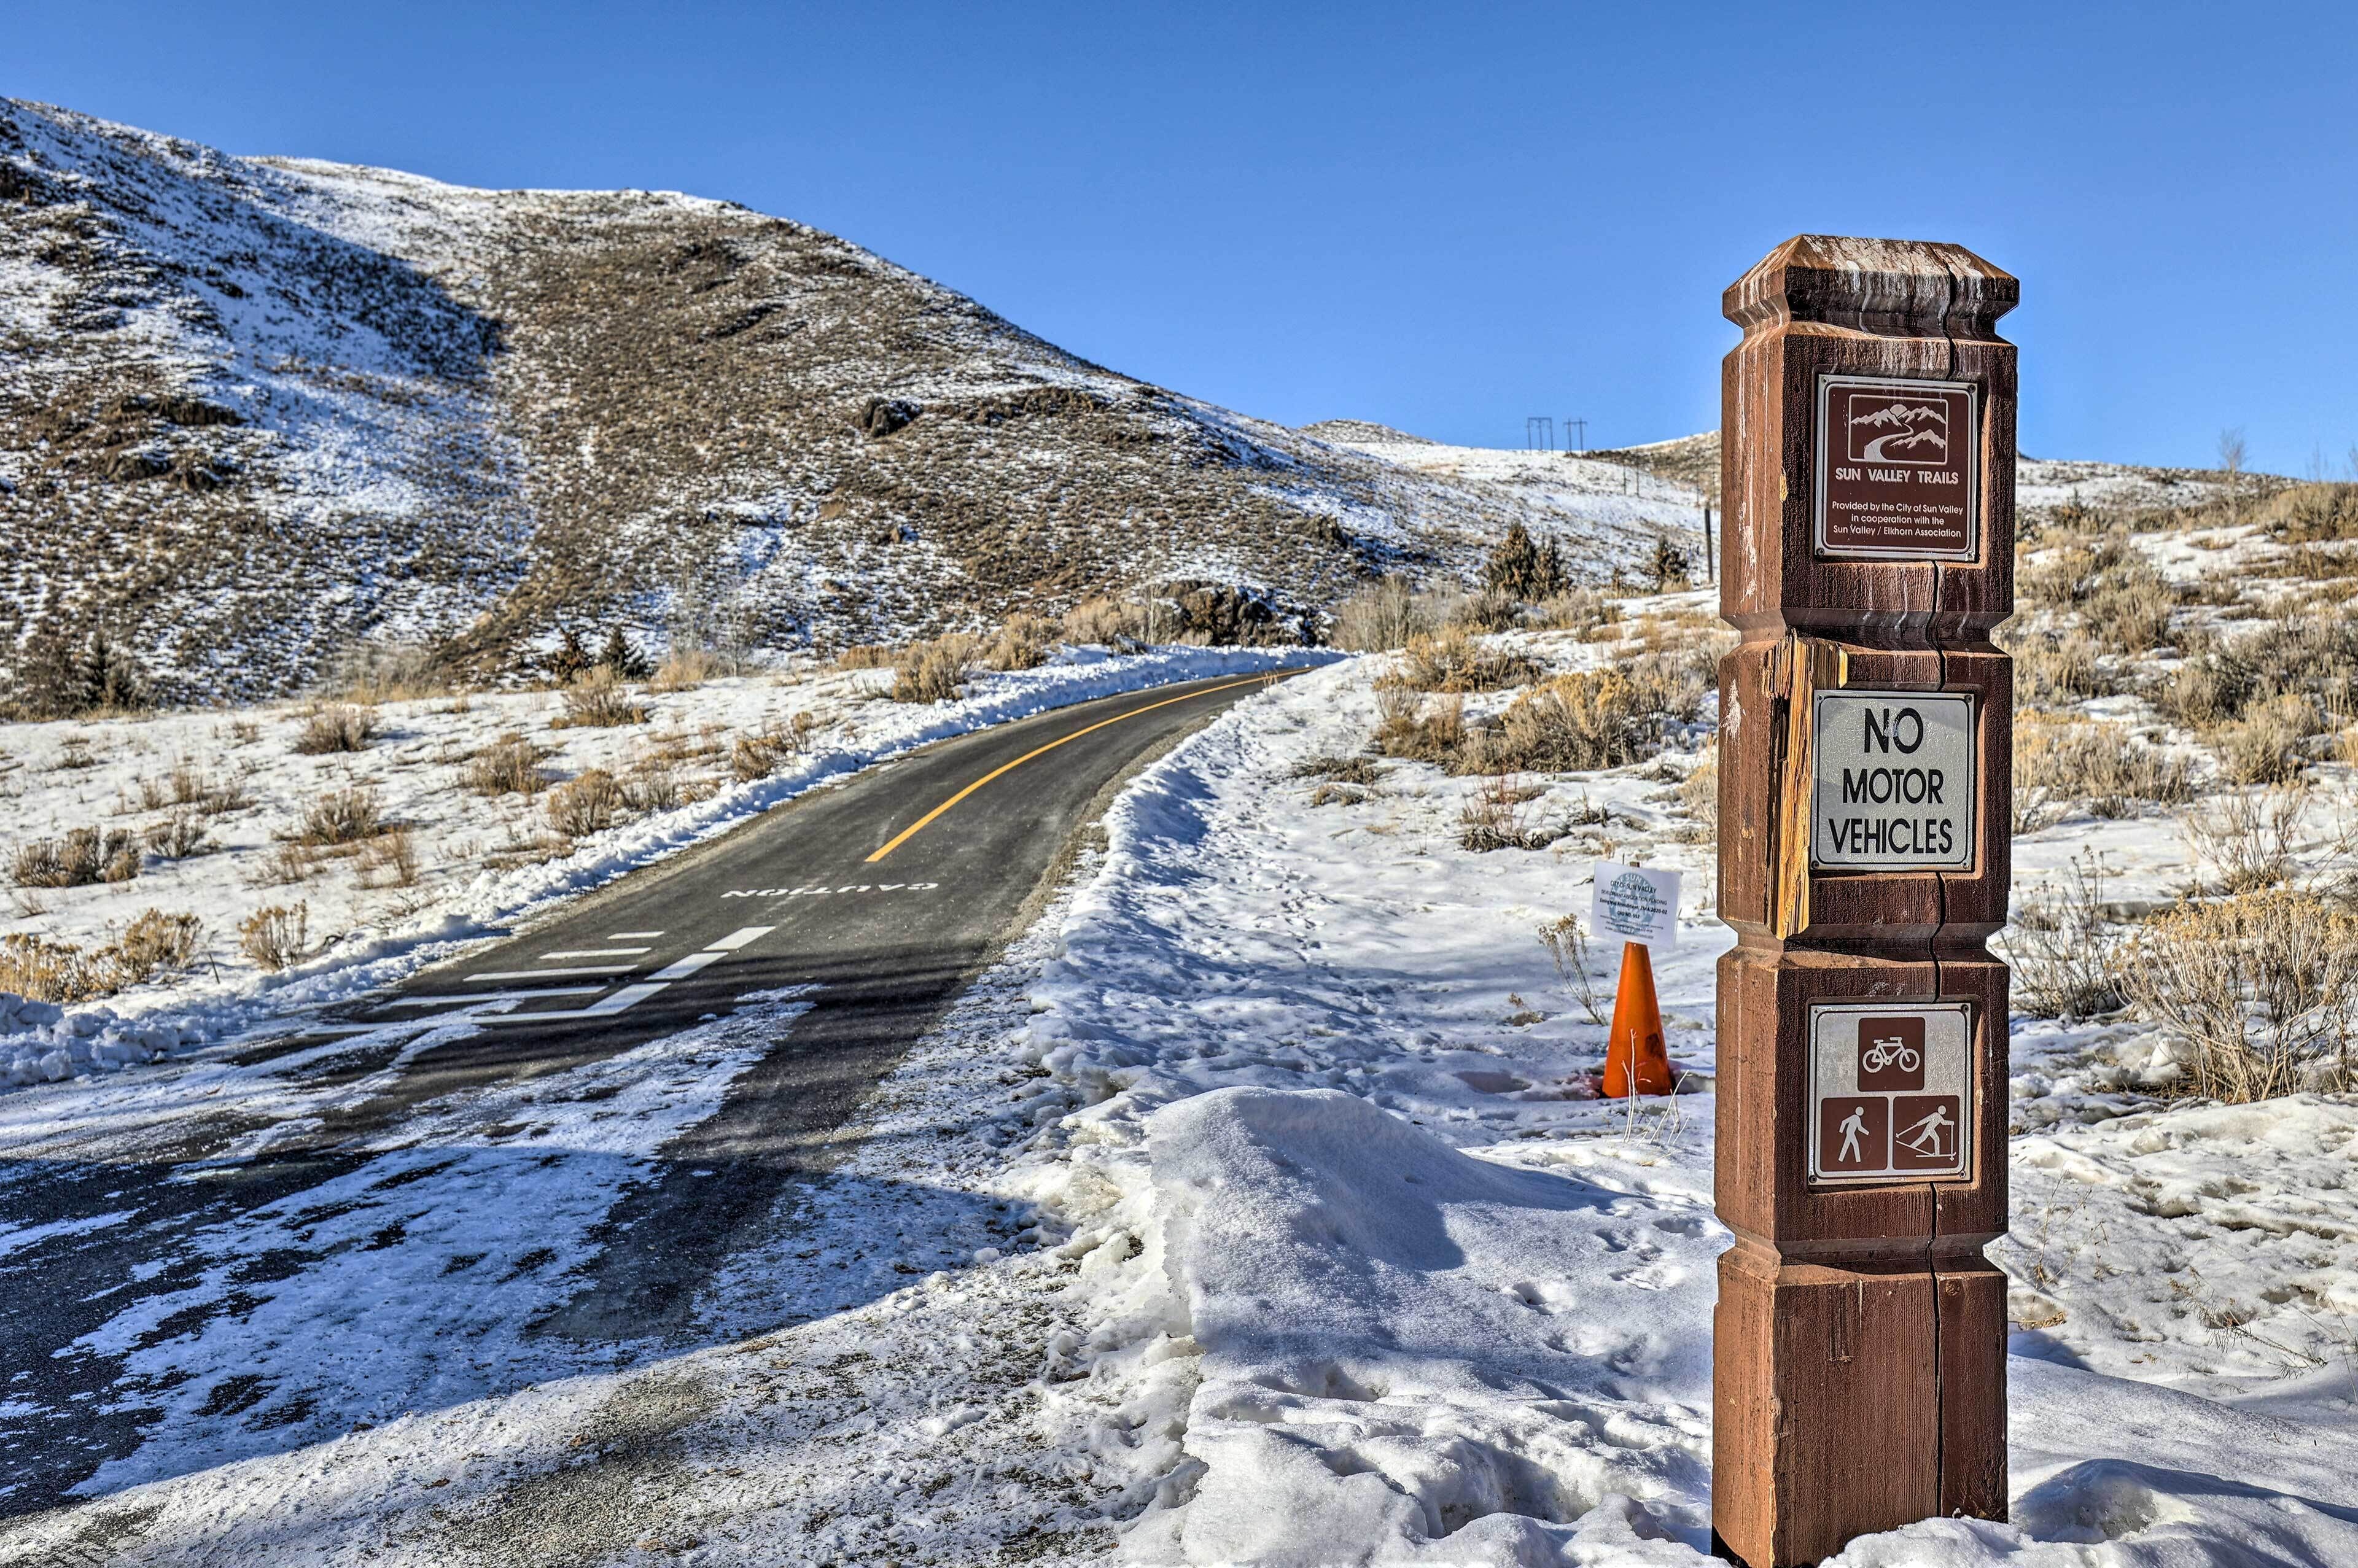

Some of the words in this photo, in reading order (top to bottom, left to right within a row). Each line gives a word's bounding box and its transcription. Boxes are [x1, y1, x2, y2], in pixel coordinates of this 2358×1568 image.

[1835, 468, 1861, 481] SUN
[1867, 468, 1911, 483] VALLEY
[1917, 471, 1959, 485] TRAILS
[1832, 500, 1868, 511] Provided
[1870, 502, 1880, 513] by
[1881, 502, 1894, 511] the
[1896, 503, 1912, 514] City
[1913, 504, 1923, 513] of
[1923, 505, 1937, 513] Sun
[1939, 505, 1964, 515] Valley
[1851, 513, 1859, 522] in
[1861, 514, 1912, 525] cooperation
[1913, 516, 1929, 524] with
[1931, 517, 1945, 526] the
[1833, 524, 1848, 534] Sun
[1850, 525, 1876, 535] Valley
[1877, 527, 1881, 536] /
[1883, 527, 1913, 536] Elkhorn
[1915, 528, 1961, 537] Association
[1864, 707, 1924, 755] NO
[1842, 768, 1944, 804] MOTOR
[1828, 818, 1953, 854] VEHICLES
[720, 882, 940, 898] CAUTION
